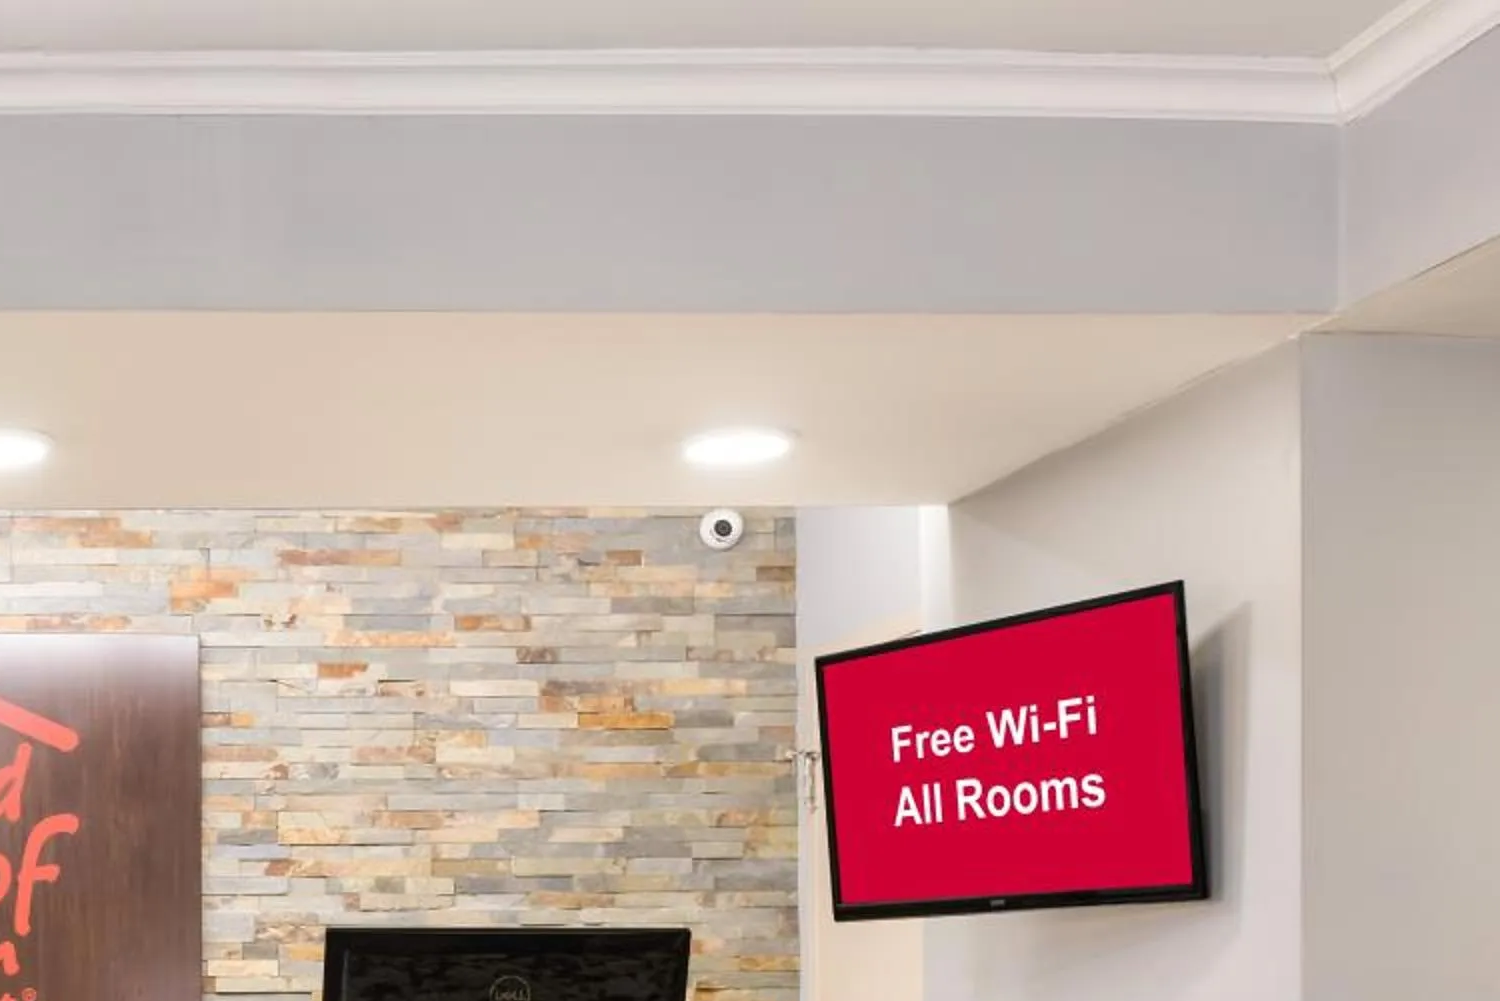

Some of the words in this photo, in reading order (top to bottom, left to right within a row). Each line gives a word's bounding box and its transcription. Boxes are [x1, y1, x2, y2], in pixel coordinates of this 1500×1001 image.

[891, 724, 975, 763] Free
[985, 695, 1098, 748] Wi-Fi
[894, 782, 943, 827] All
[955, 773, 1106, 821] Rooms
